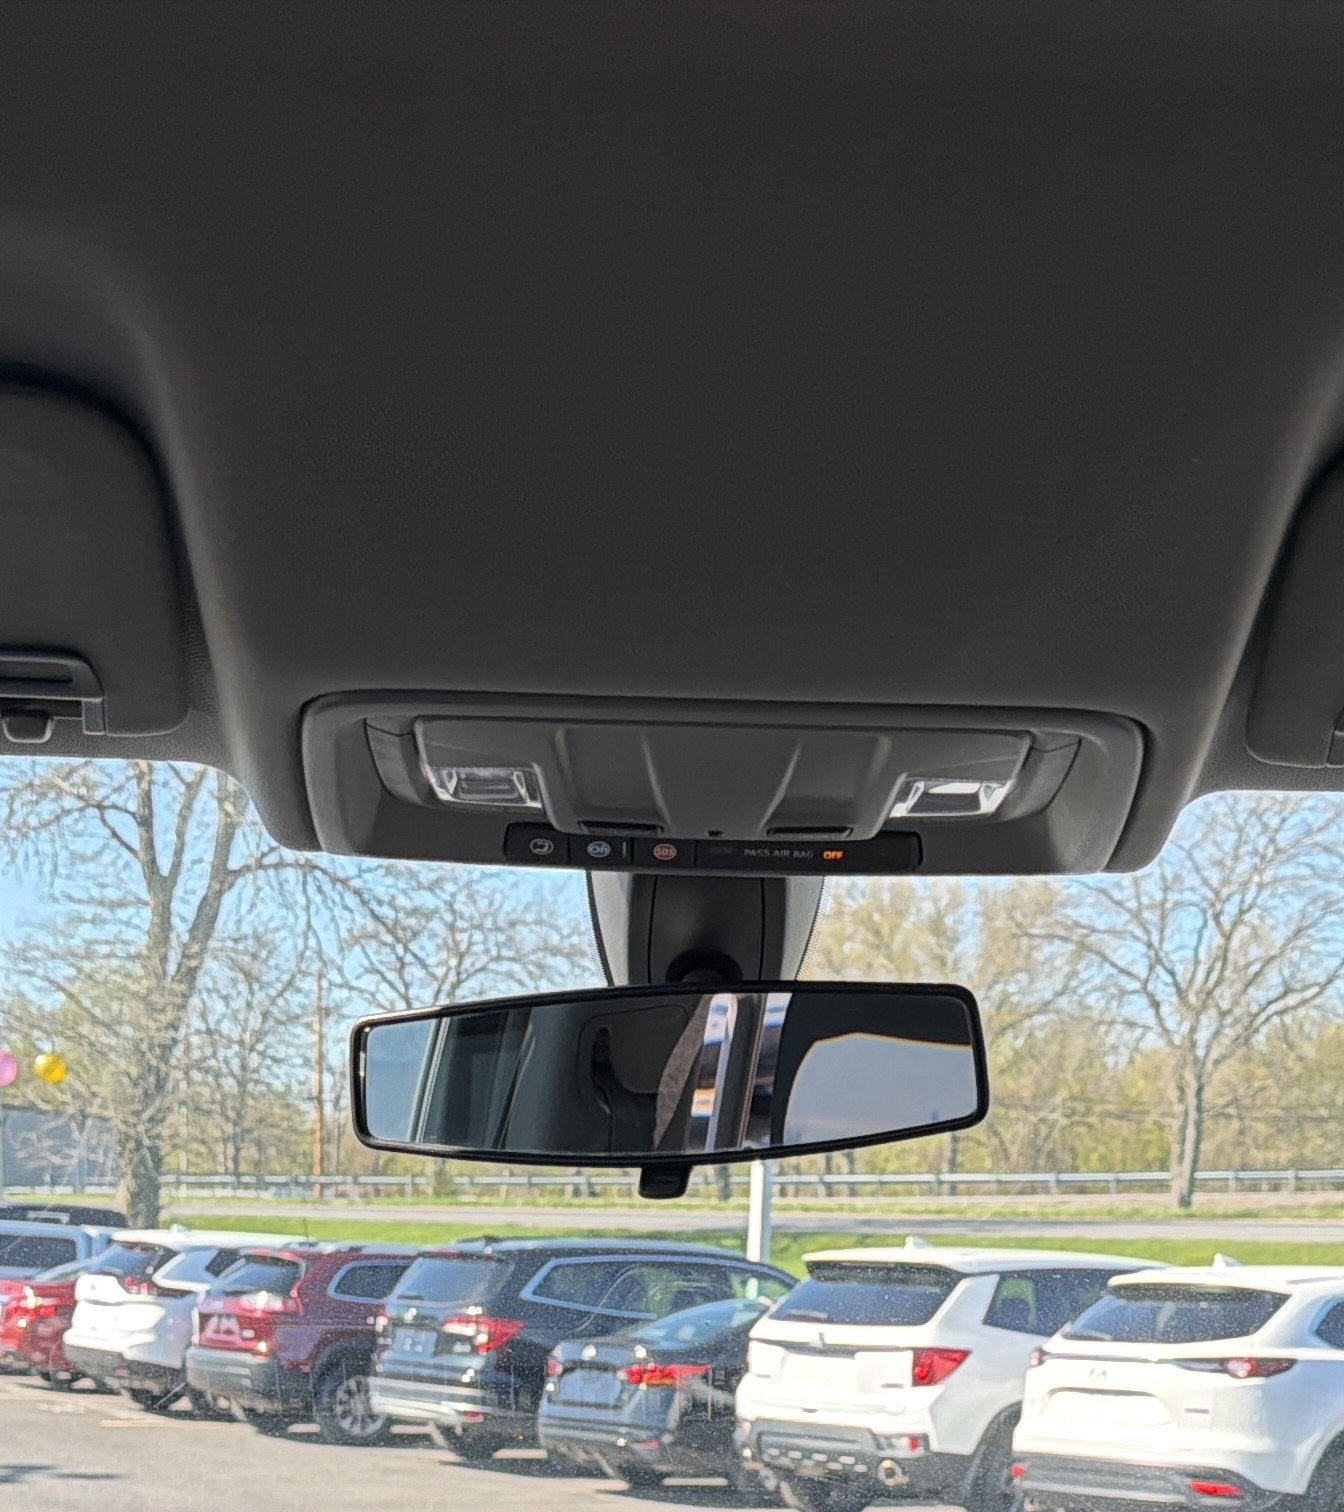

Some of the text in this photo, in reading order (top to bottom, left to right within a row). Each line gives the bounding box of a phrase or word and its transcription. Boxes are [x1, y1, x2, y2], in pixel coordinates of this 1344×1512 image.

[654, 848, 676, 858] SOS
[744, 848, 771, 858] PASS
[773, 850, 790, 858] AIR
[792, 850, 813, 860] BAG
[822, 850, 844, 860] OFF
